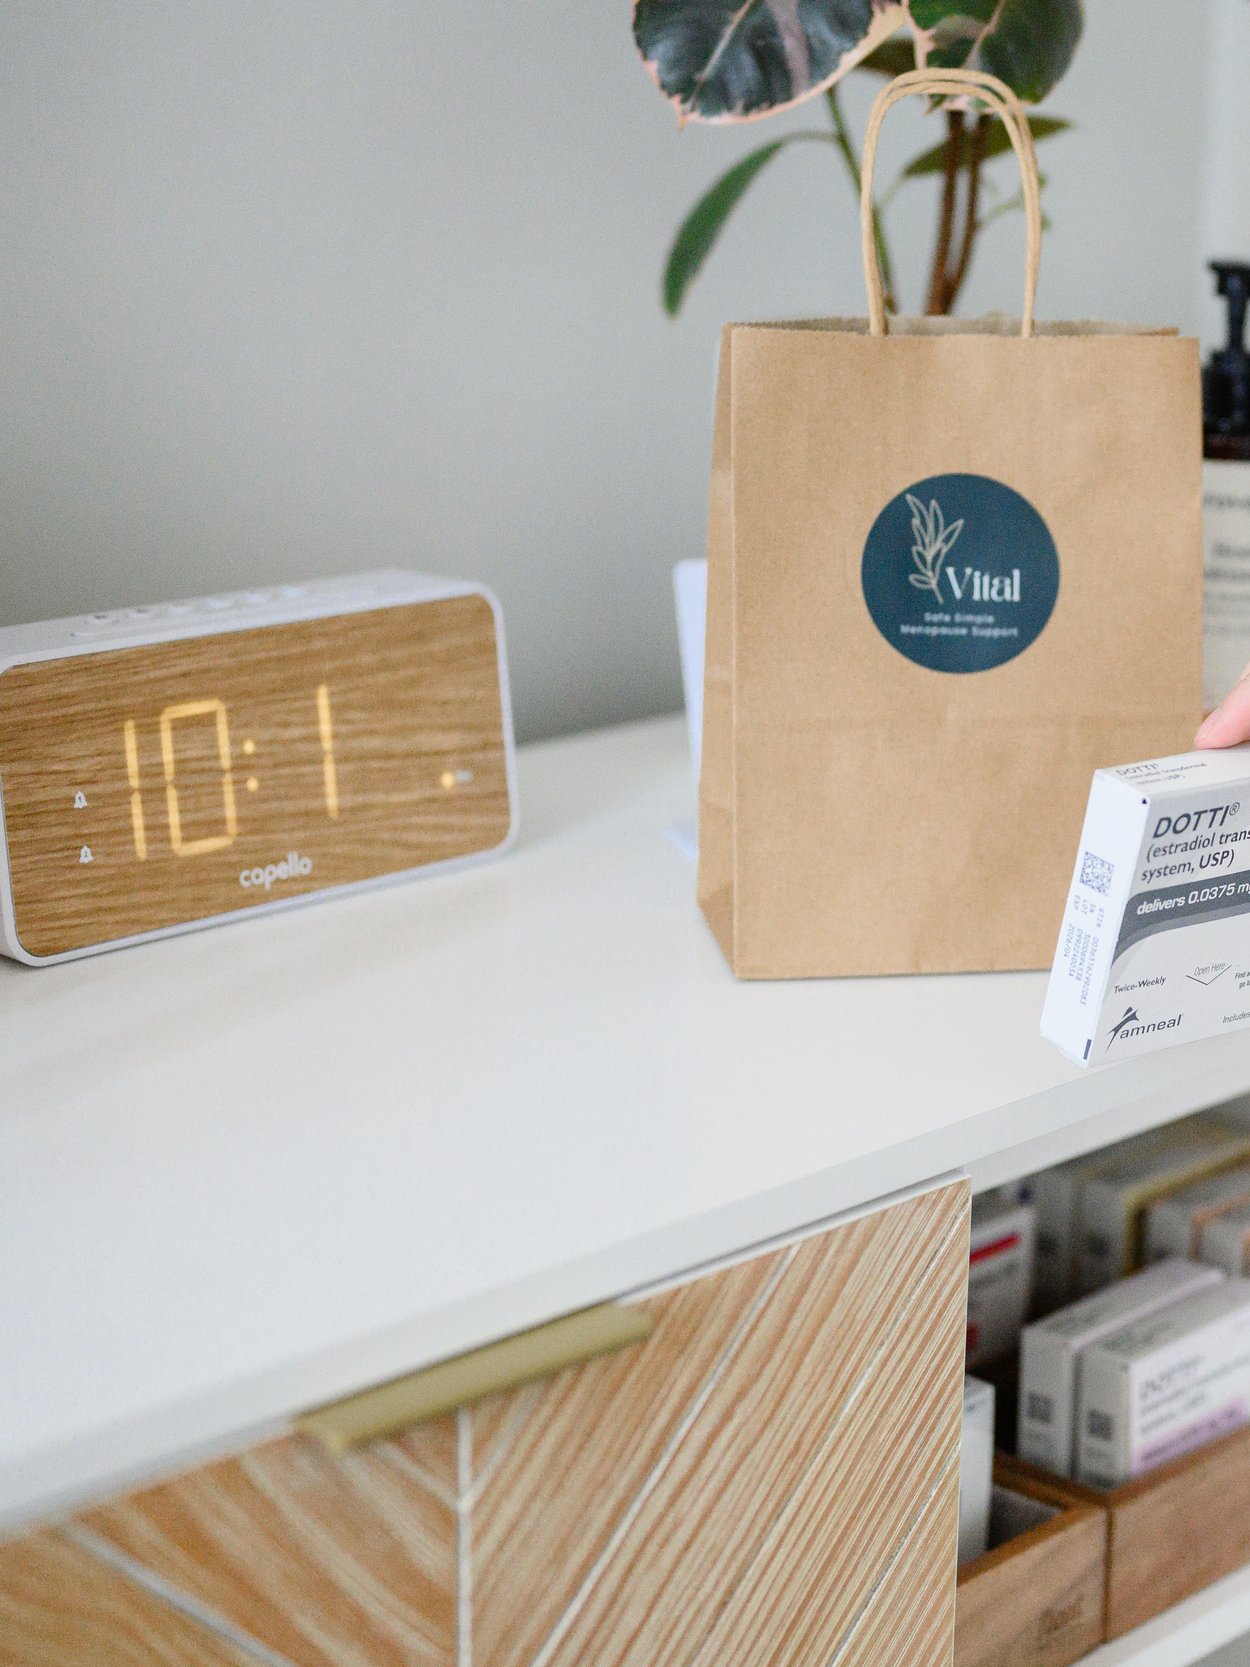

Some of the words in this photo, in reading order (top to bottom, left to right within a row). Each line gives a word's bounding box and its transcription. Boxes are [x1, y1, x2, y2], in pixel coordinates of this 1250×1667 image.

[946, 566, 1020, 602] Vital
[1146, 833, 1216, 863] (estradiol
[240, 851, 312, 893] capello
[1141, 861, 1195, 883] system,
[1198, 849, 1235, 868] USP)
[1136, 896, 1186, 915] delivers
[1188, 883, 1236, 905] 0.0375
[1114, 975, 1167, 994] Twice-Weekly
[1194, 966, 1212, 977] Open
[1211, 962, 1226, 974] Here
[1234, 972, 1246, 980] Find
[1120, 1013, 1182, 1039] amneal
